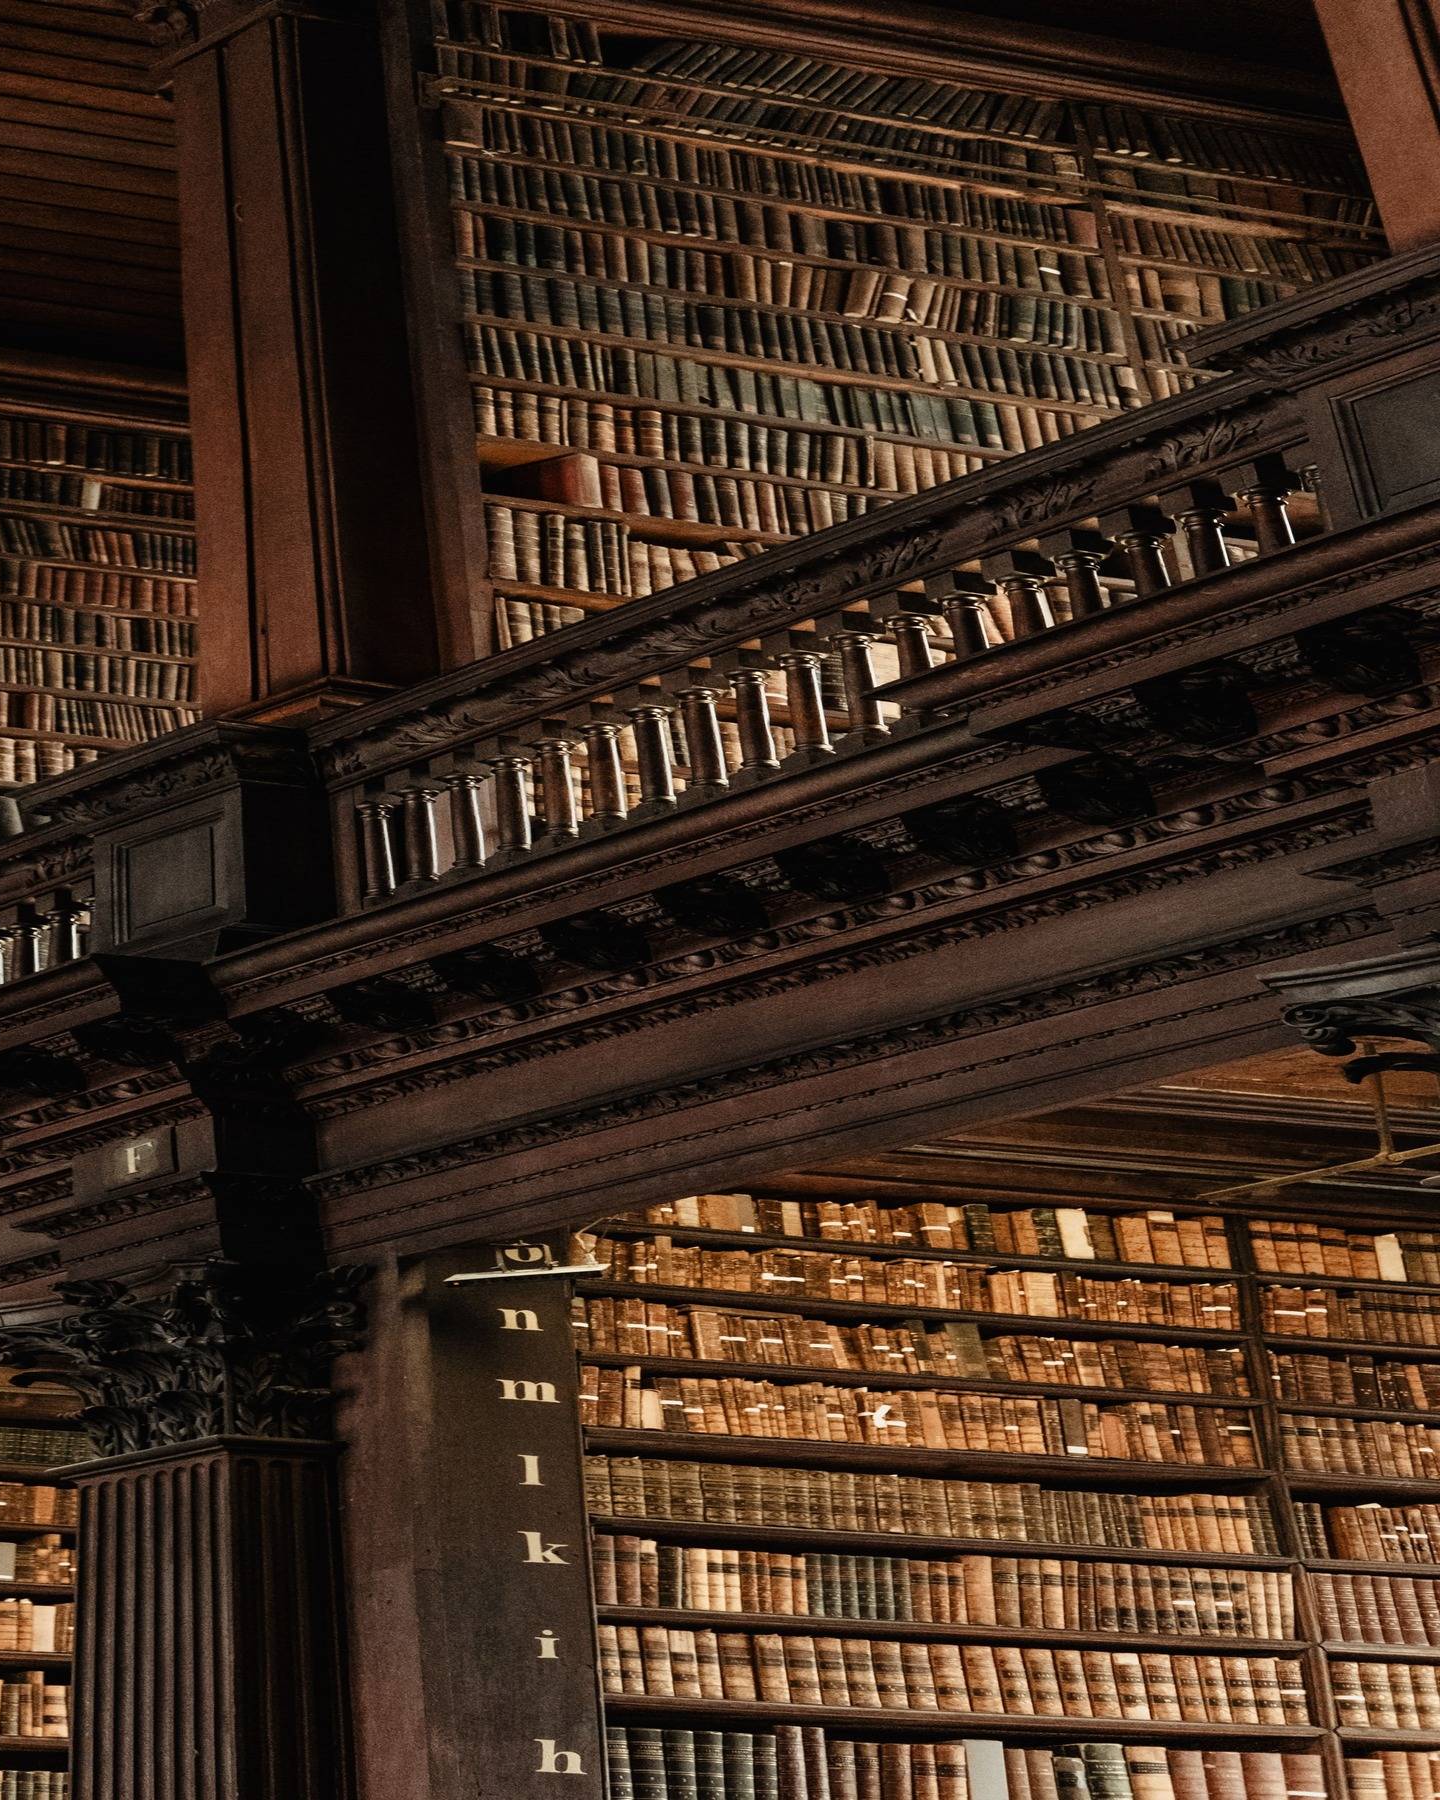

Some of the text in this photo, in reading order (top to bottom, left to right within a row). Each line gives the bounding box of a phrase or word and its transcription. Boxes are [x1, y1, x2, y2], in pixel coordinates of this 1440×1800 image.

[126, 1141, 153, 1175] F
[497, 1308, 544, 1332] n
[496, 1378, 561, 1404] m
[517, 1530, 571, 1565] k
[534, 1629, 560, 1659] i
[534, 1738, 588, 1775] h
